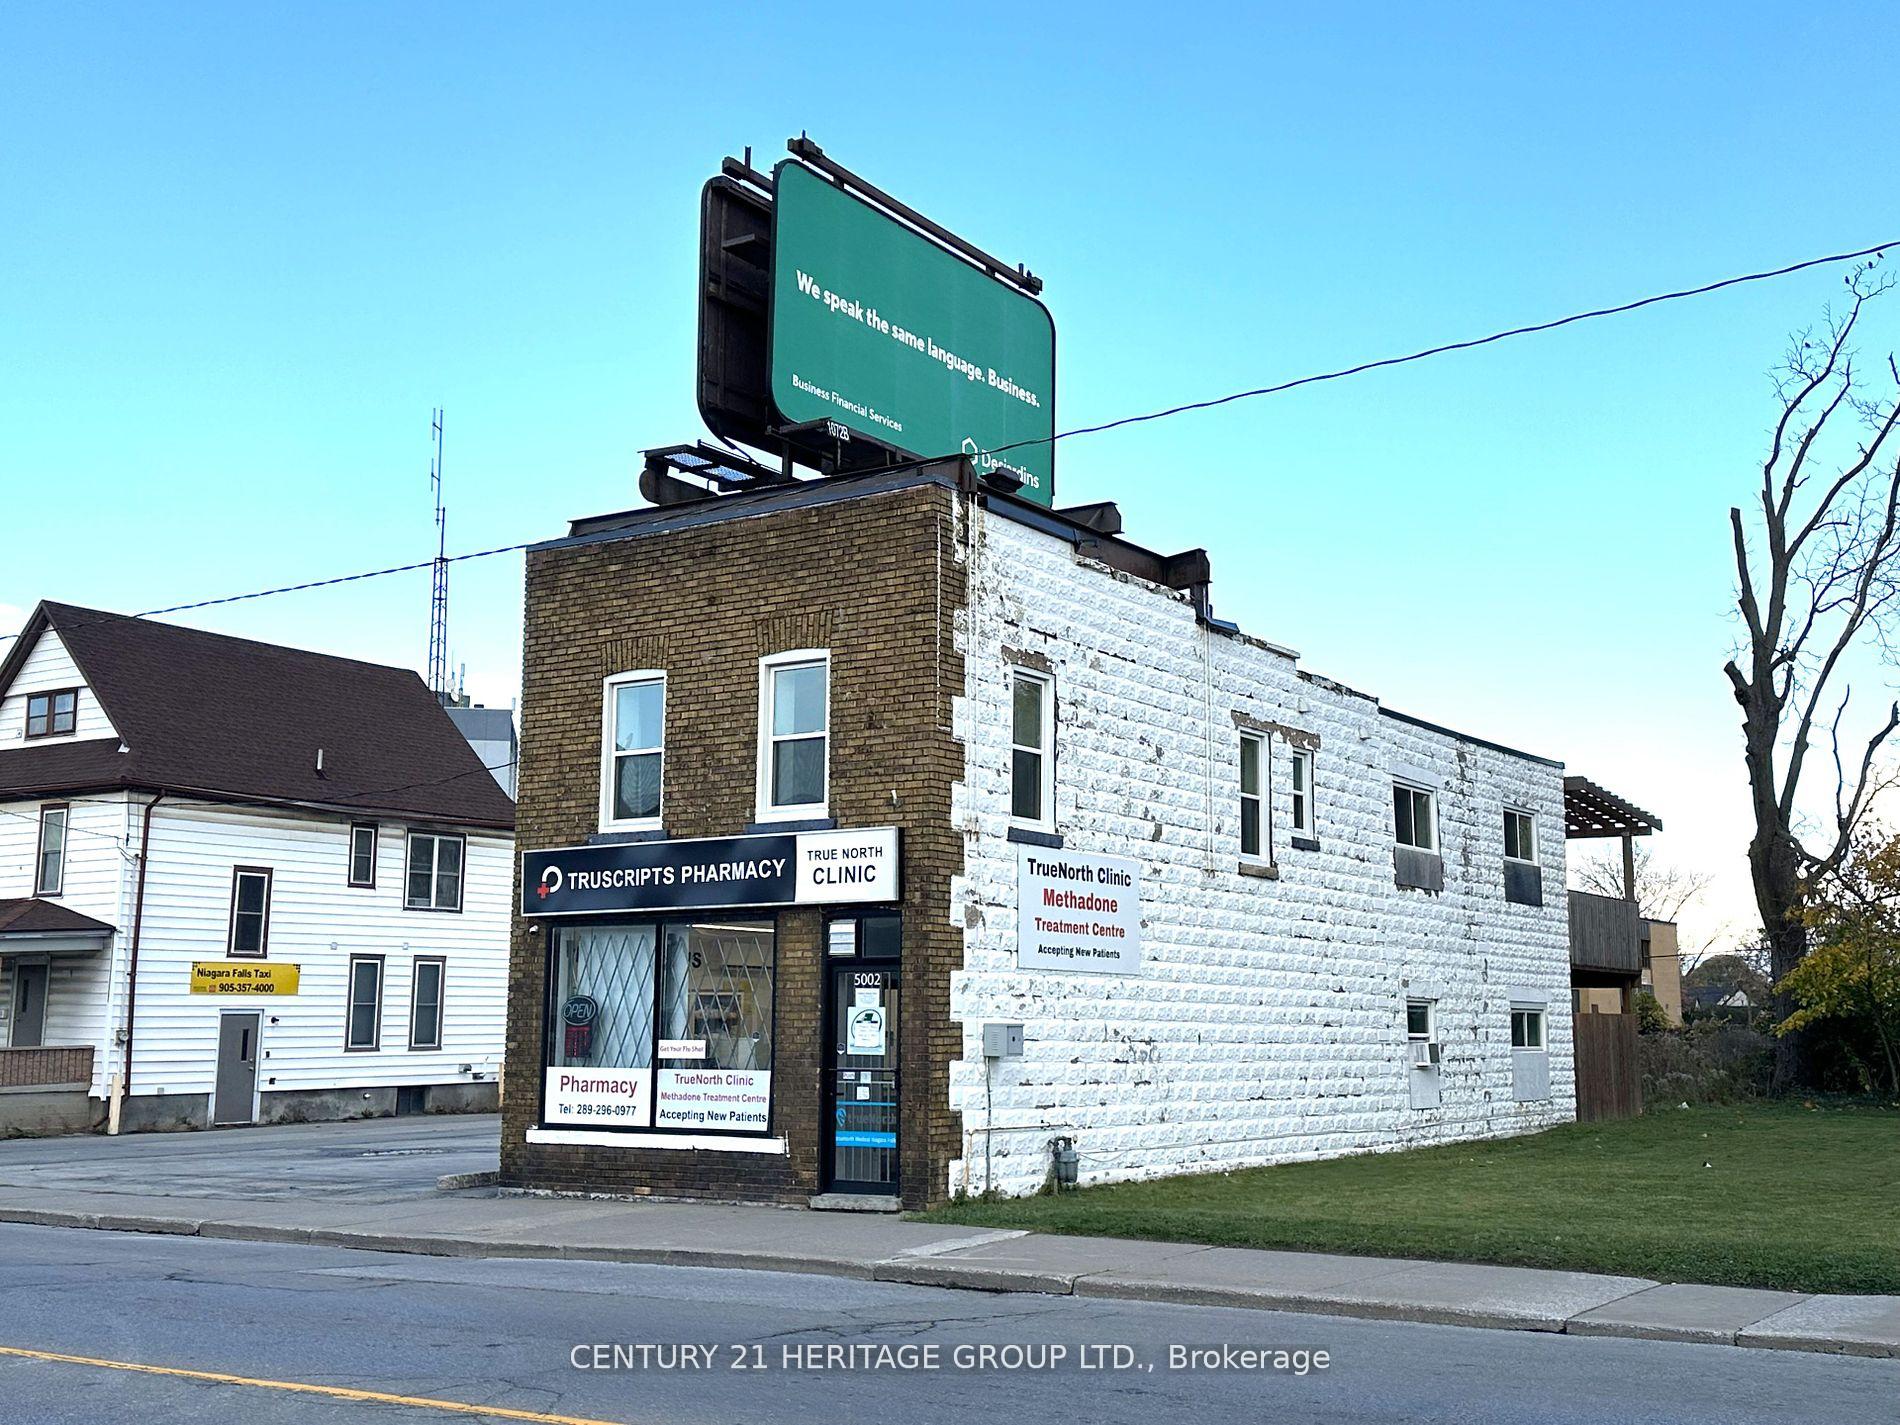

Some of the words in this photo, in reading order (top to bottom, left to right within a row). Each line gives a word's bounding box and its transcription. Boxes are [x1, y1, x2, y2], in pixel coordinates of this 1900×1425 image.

[796, 269, 820, 300] We
[823, 289, 864, 323] speak
[866, 308, 890, 334] the
[891, 324, 925, 352] same
[927, 336, 985, 381] language.
[988, 368, 1040, 408] Business.
[792, 373, 830, 401] Business
[831, 391, 868, 418] Financial
[869, 408, 903, 432] Services
[826, 421, 850, 441] 1072B
[807, 848, 838, 861] TRUE
[842, 846, 883, 860] NORTH
[567, 866, 675, 890] TRUSCRIPTS
[681, 858, 786, 884] PHARMACY
[813, 864, 876, 885] CLINIC
[1027, 857, 1094, 883] TrueNorth
[1097, 867, 1132, 887] Clinic
[1043, 888, 1118, 913] Methadone
[1034, 917, 1089, 936] Treatment
[1092, 922, 1125, 938] Centre
[1037, 944, 1074, 959] Accepting
[1075, 947, 1091, 957] New
[1092, 948, 1120, 959] Patients
[197, 968, 230, 979] Niagara
[232, 968, 252, 978] Falls
[254, 969, 271, 979] Taxi
[854, 973, 881, 986] 5002
[218, 983, 275, 993] 905-357-4000
[563, 1003, 593, 1018] OPEN
[560, 1075, 638, 1098] Pharmacy
[675, 1073, 723, 1085] TrueNorth
[726, 1074, 754, 1086] Clinic
[661, 1091, 701, 1102] Methadone
[703, 1092, 740, 1103] Treatment
[741, 1094, 767, 1103] Centre
[559, 1103, 574, 1114] Tel:
[577, 1104, 637, 1116] 289-296-0977
[659, 1109, 705, 1122] Accepting
[707, 1110, 727, 1121] New
[729, 1111, 767, 1123] Patients
